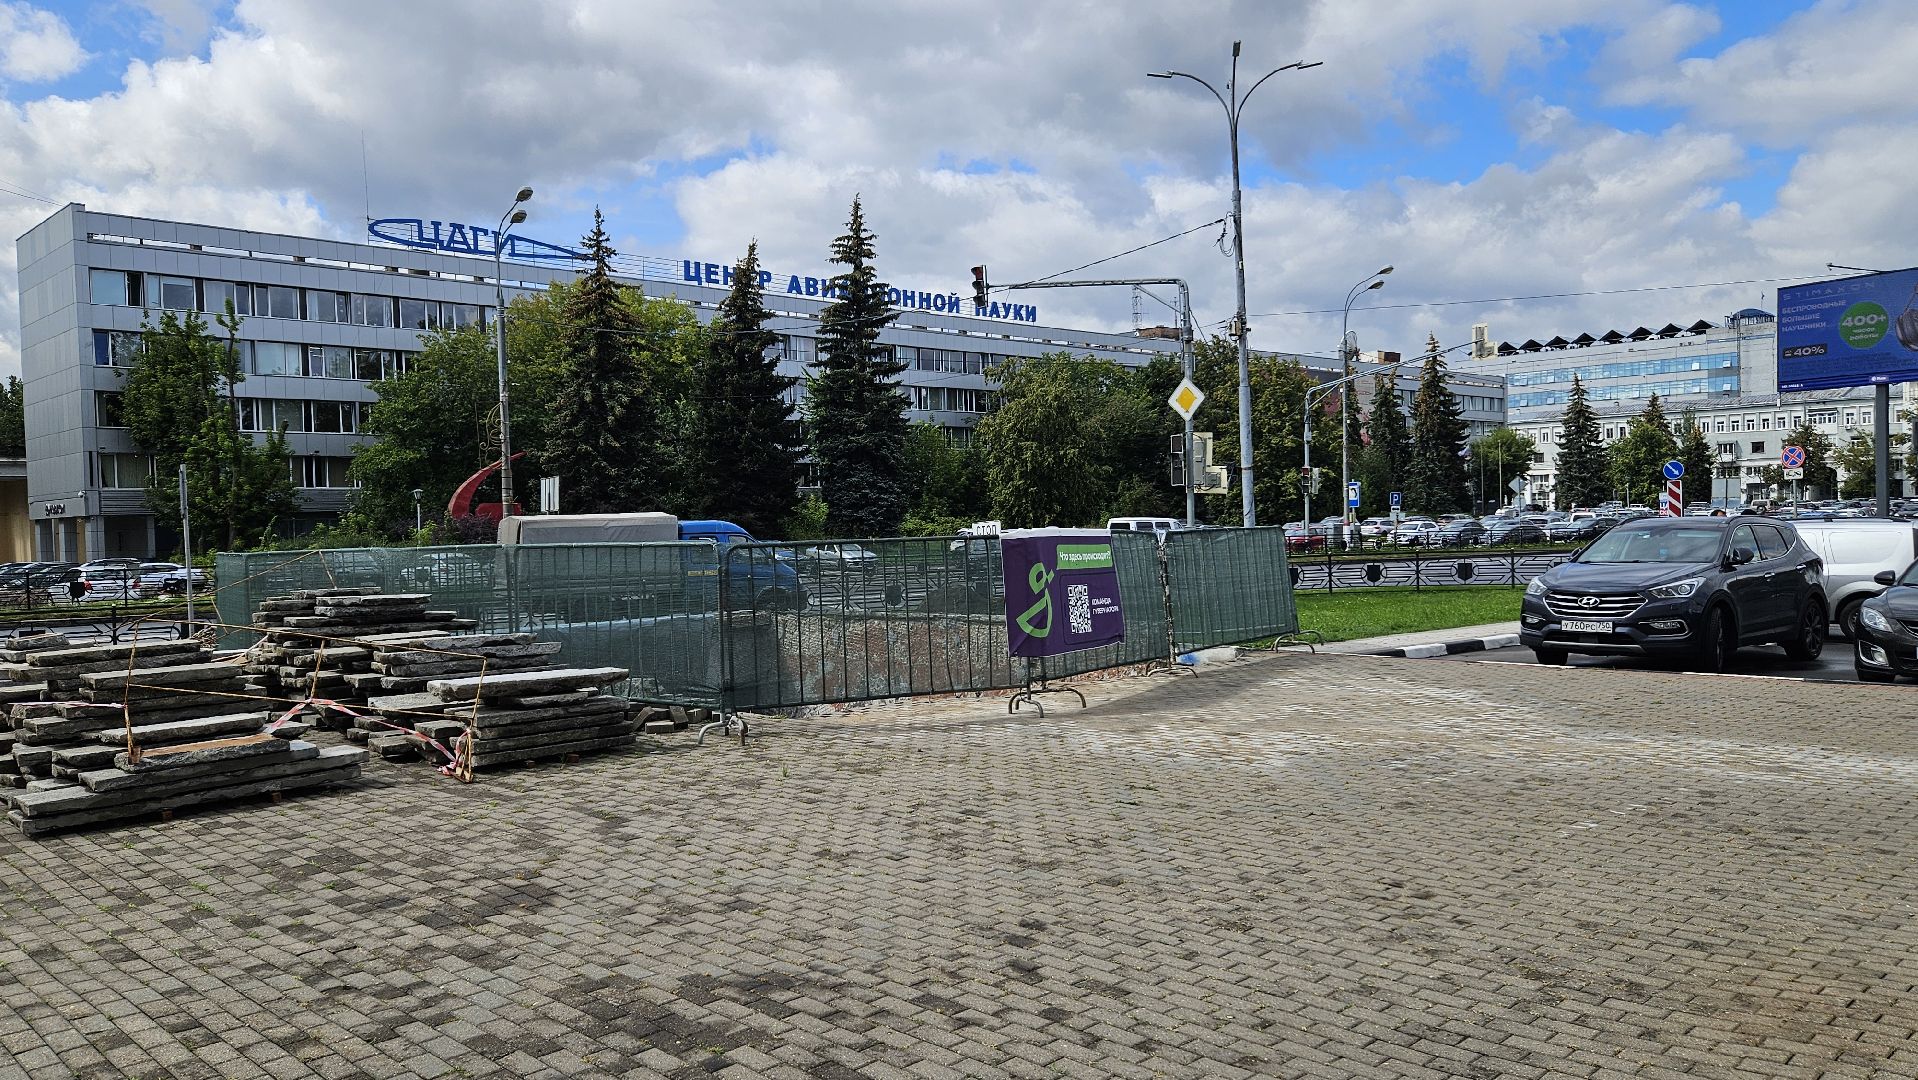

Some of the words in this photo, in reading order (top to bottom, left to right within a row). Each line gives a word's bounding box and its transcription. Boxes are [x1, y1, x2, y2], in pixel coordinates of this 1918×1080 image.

[684, 260, 772, 290] ЦЕНР
[1782, 300, 1847, 314] БЕСПРОВОДНЫЕ
[1782, 313, 1821, 323] БОЛЬШИЕ
[1842, 314, 1887, 327] 400+
[1059, 551, 1069, 561] Что
[1091, 597, 1112, 606] КОМАНДА
